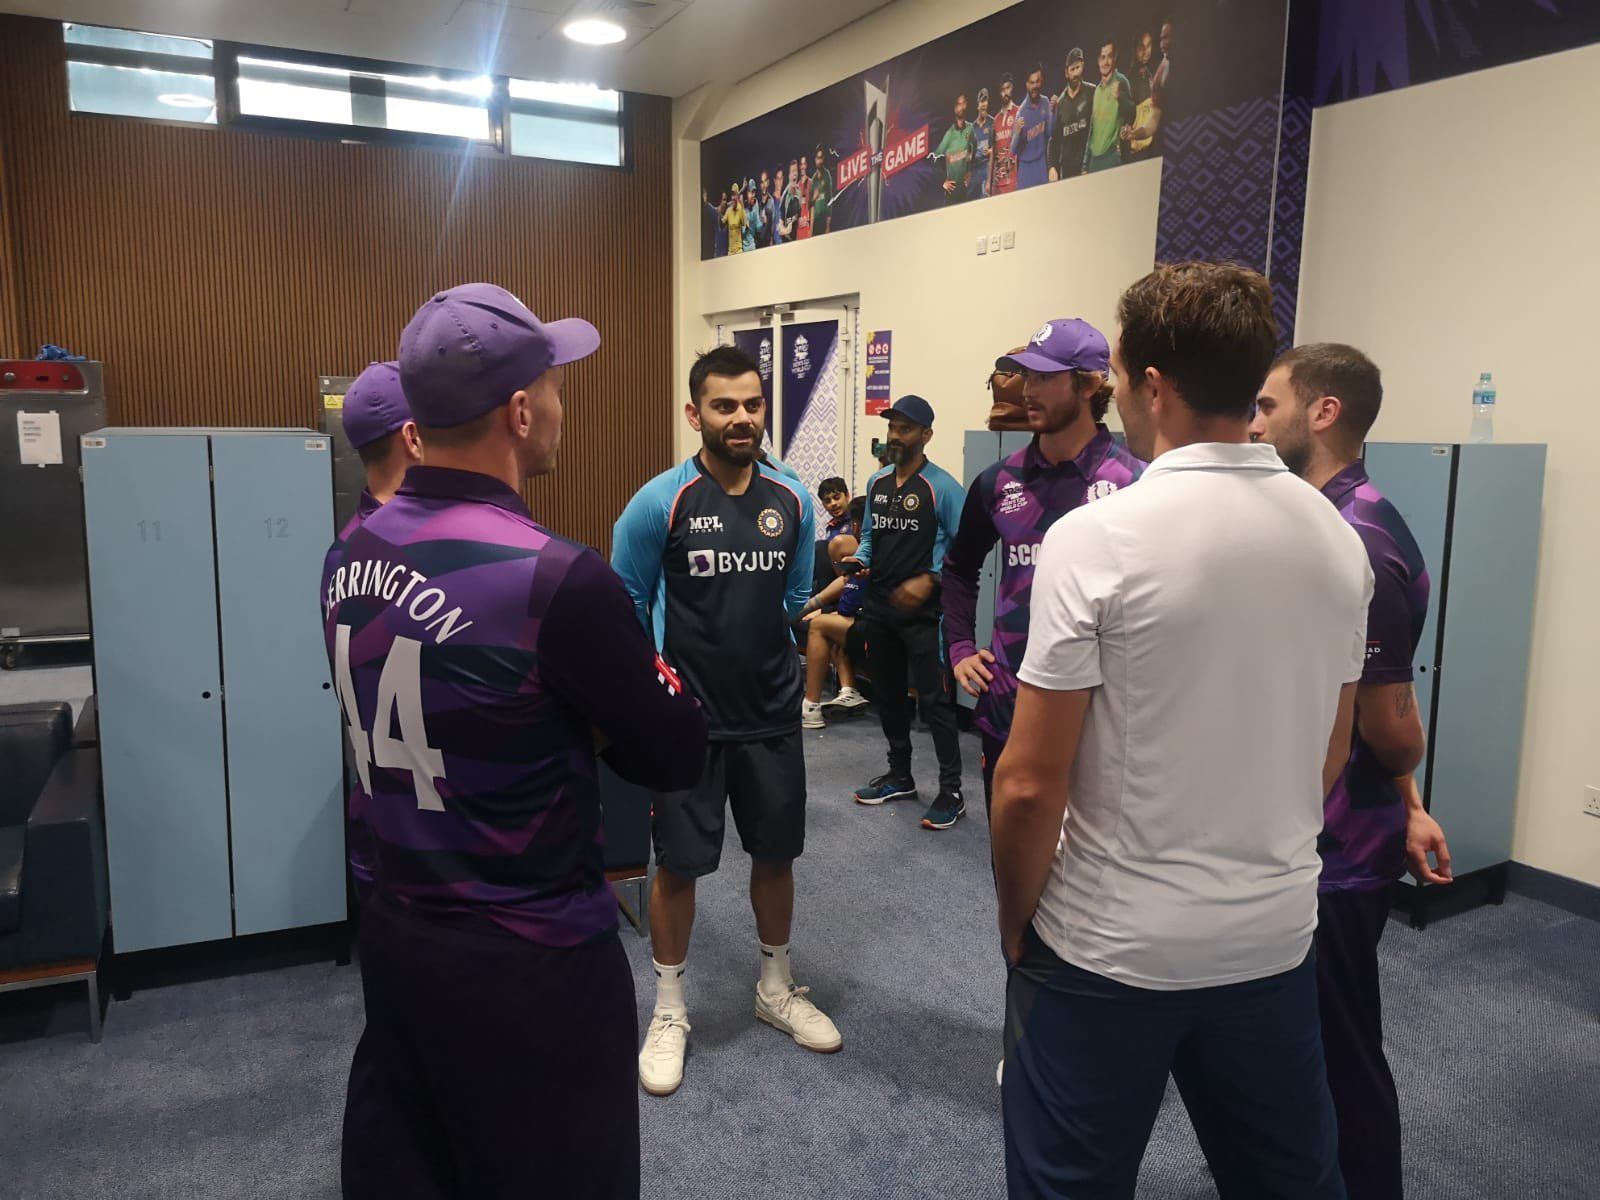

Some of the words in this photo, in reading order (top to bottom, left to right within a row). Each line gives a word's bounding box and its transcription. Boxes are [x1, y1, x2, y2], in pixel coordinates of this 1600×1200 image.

[840, 150, 868, 184] LIVE
[871, 152, 883, 166] THE
[884, 131, 926, 172] GAME
[136, 519, 161, 542] 11
[264, 517, 289, 539] 12
[689, 515, 723, 530] MPL
[879, 515, 919, 531] BYJU'S
[718, 550, 786, 573] BYJU'S
[326, 559, 473, 645] ERRINGTON
[335, 623, 447, 812] 44
